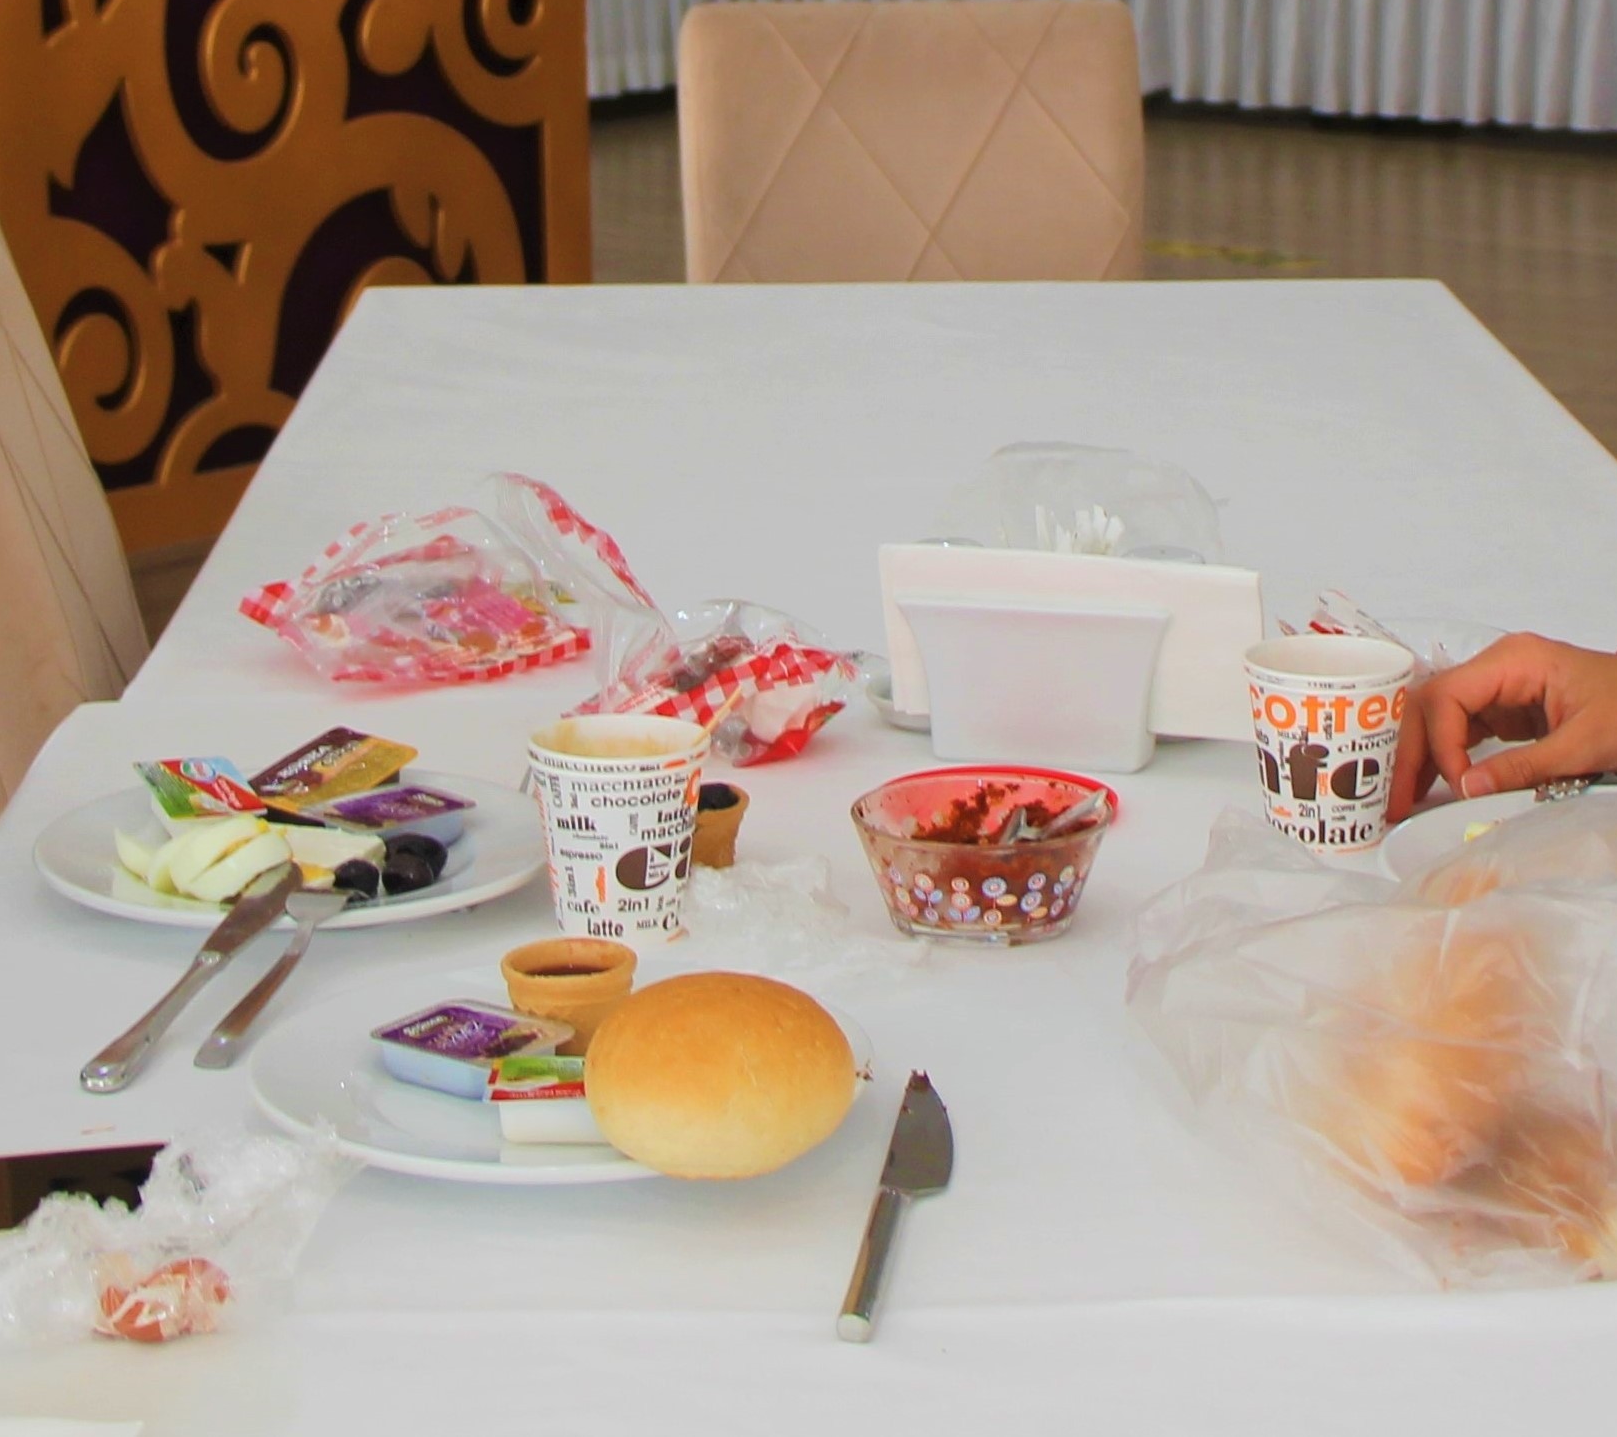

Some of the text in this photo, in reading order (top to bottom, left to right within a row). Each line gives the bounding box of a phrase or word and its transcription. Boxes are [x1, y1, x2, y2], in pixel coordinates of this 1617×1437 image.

[571, 774, 673, 794] macchiato
[590, 787, 682, 809] chocolate
[556, 814, 598, 832] milk
[617, 895, 650, 913] 2in1
[587, 916, 625, 938] latte
